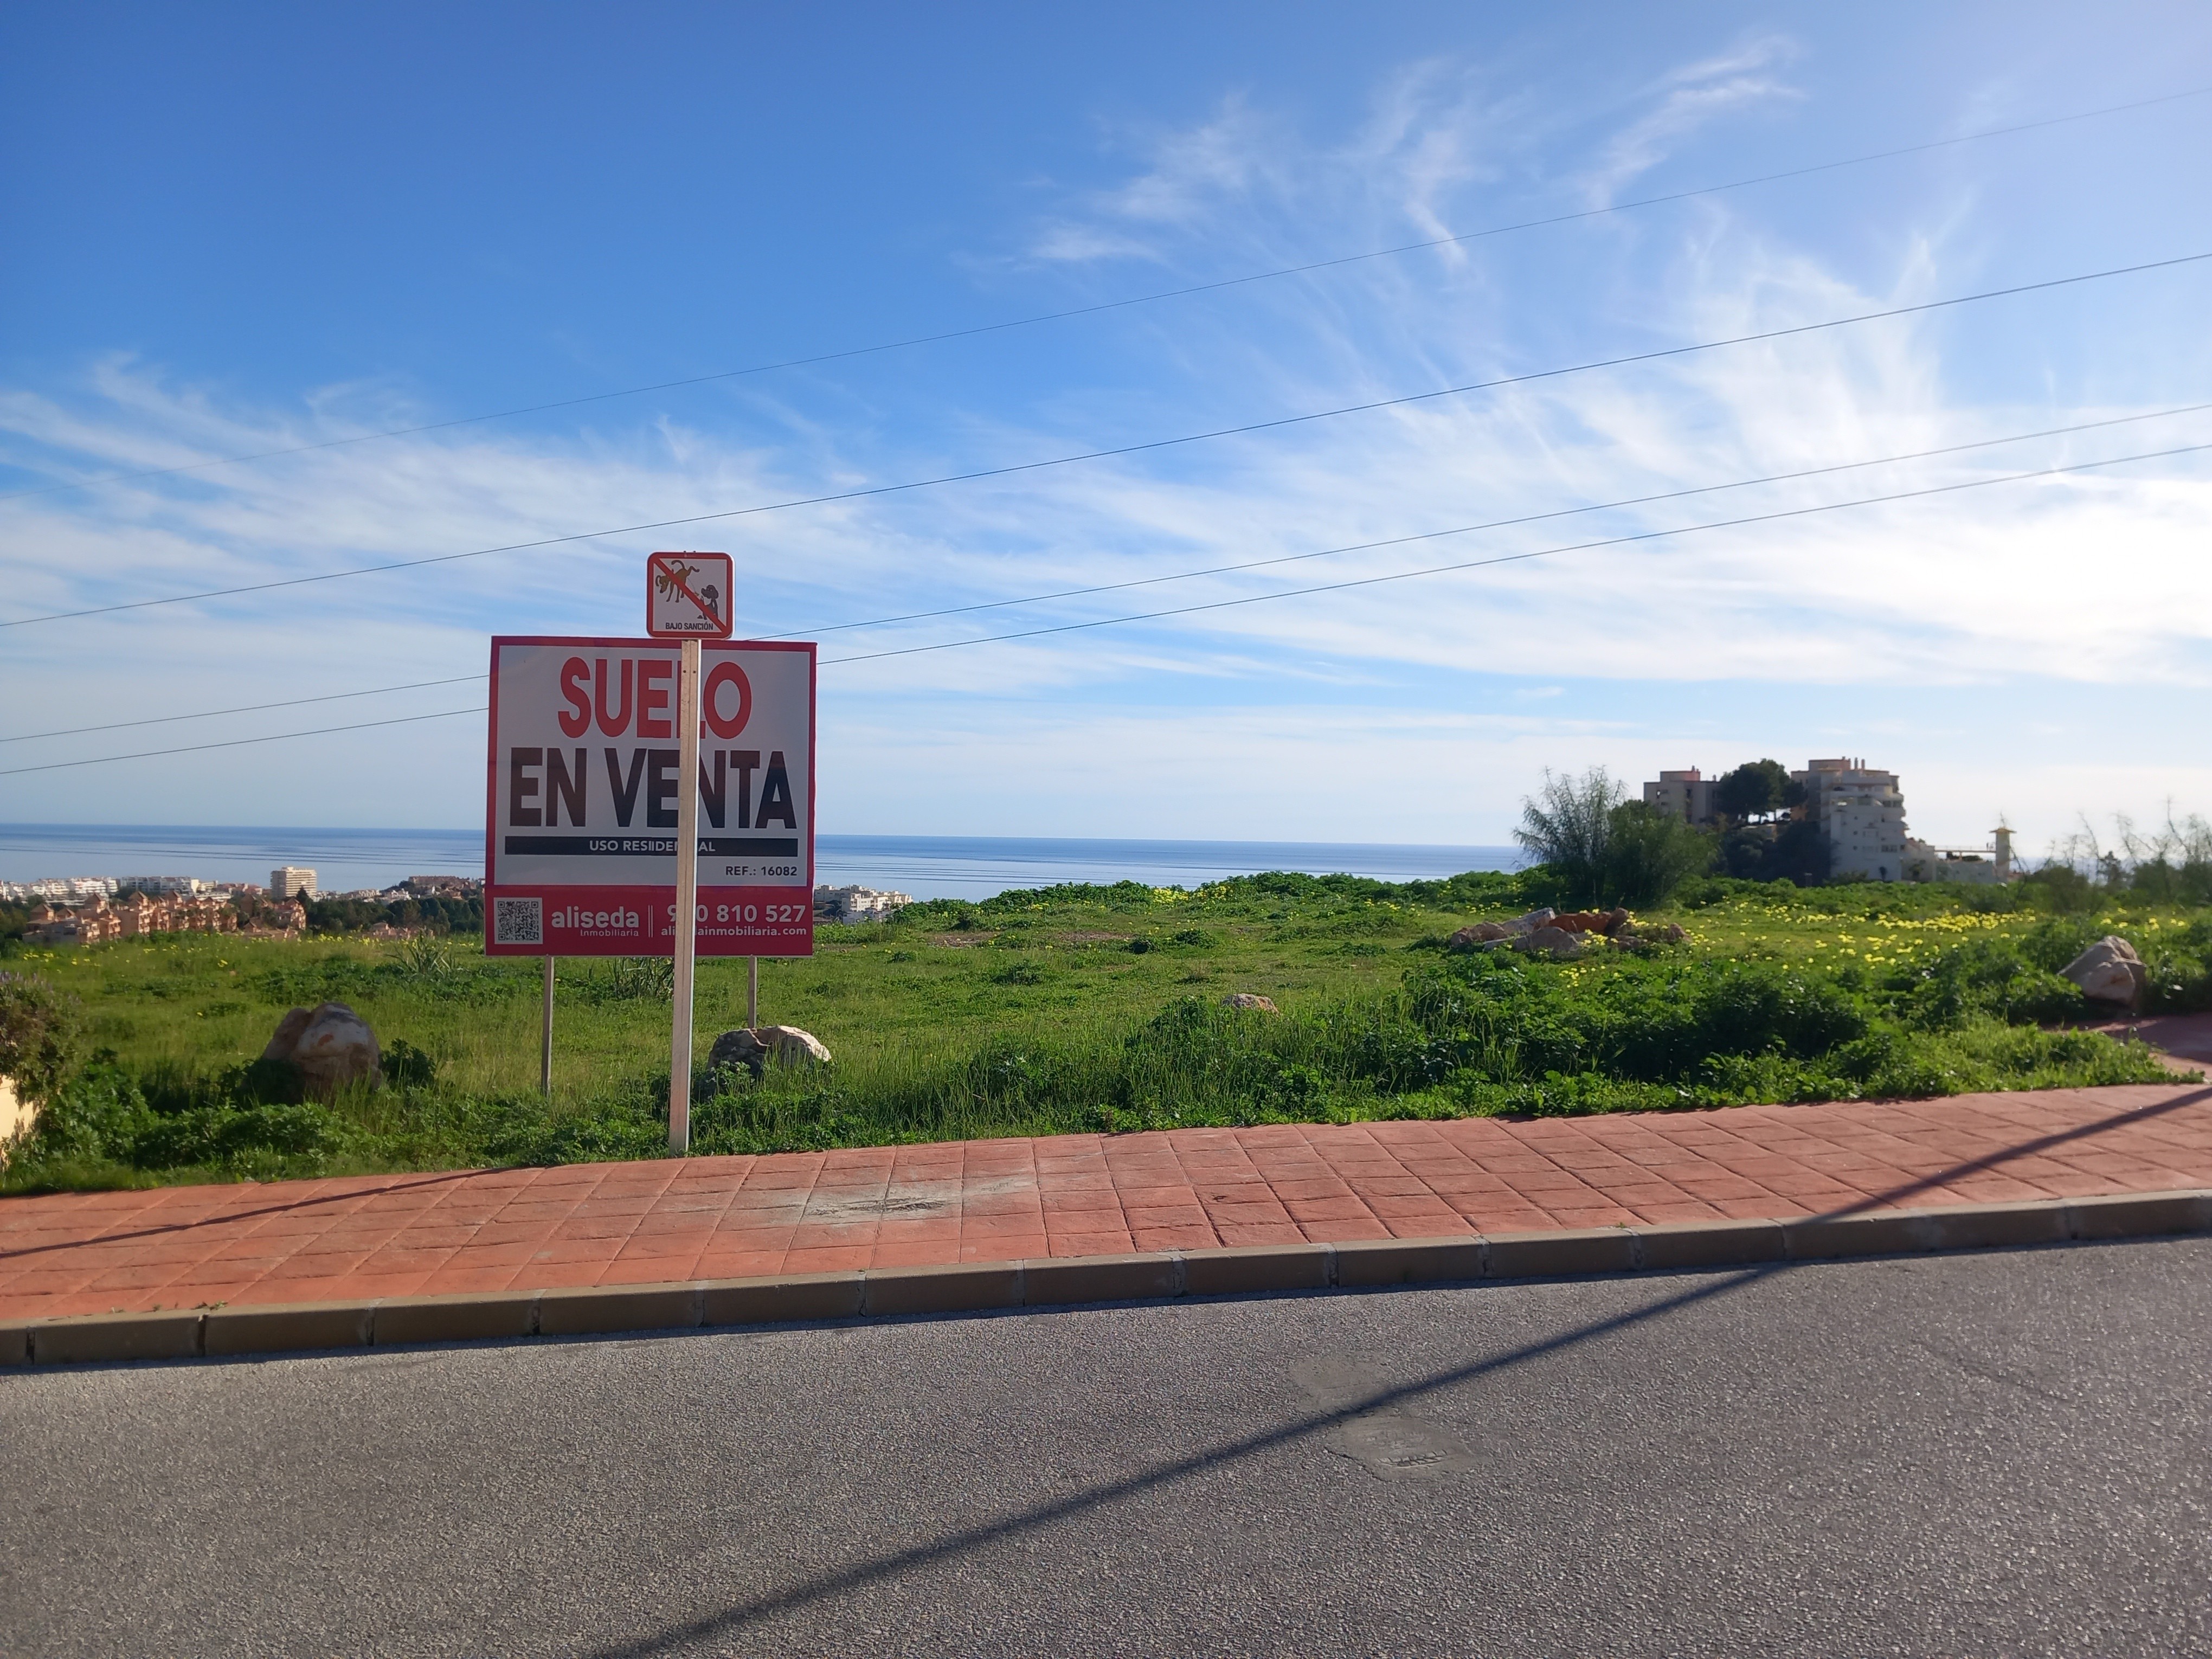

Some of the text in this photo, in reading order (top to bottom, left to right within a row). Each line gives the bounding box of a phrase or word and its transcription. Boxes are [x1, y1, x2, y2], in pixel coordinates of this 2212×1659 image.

[684, 622, 713, 630] SANCIÓN
[510, 747, 798, 829] EN VENTA
[589, 840, 619, 851] USO
[725, 866, 798, 876] REF.: 16082
[551, 906, 639, 928] aliseda
[667, 904, 806, 922] 90 810 527
[661, 925, 807, 936] aliainmobiliaria.com
